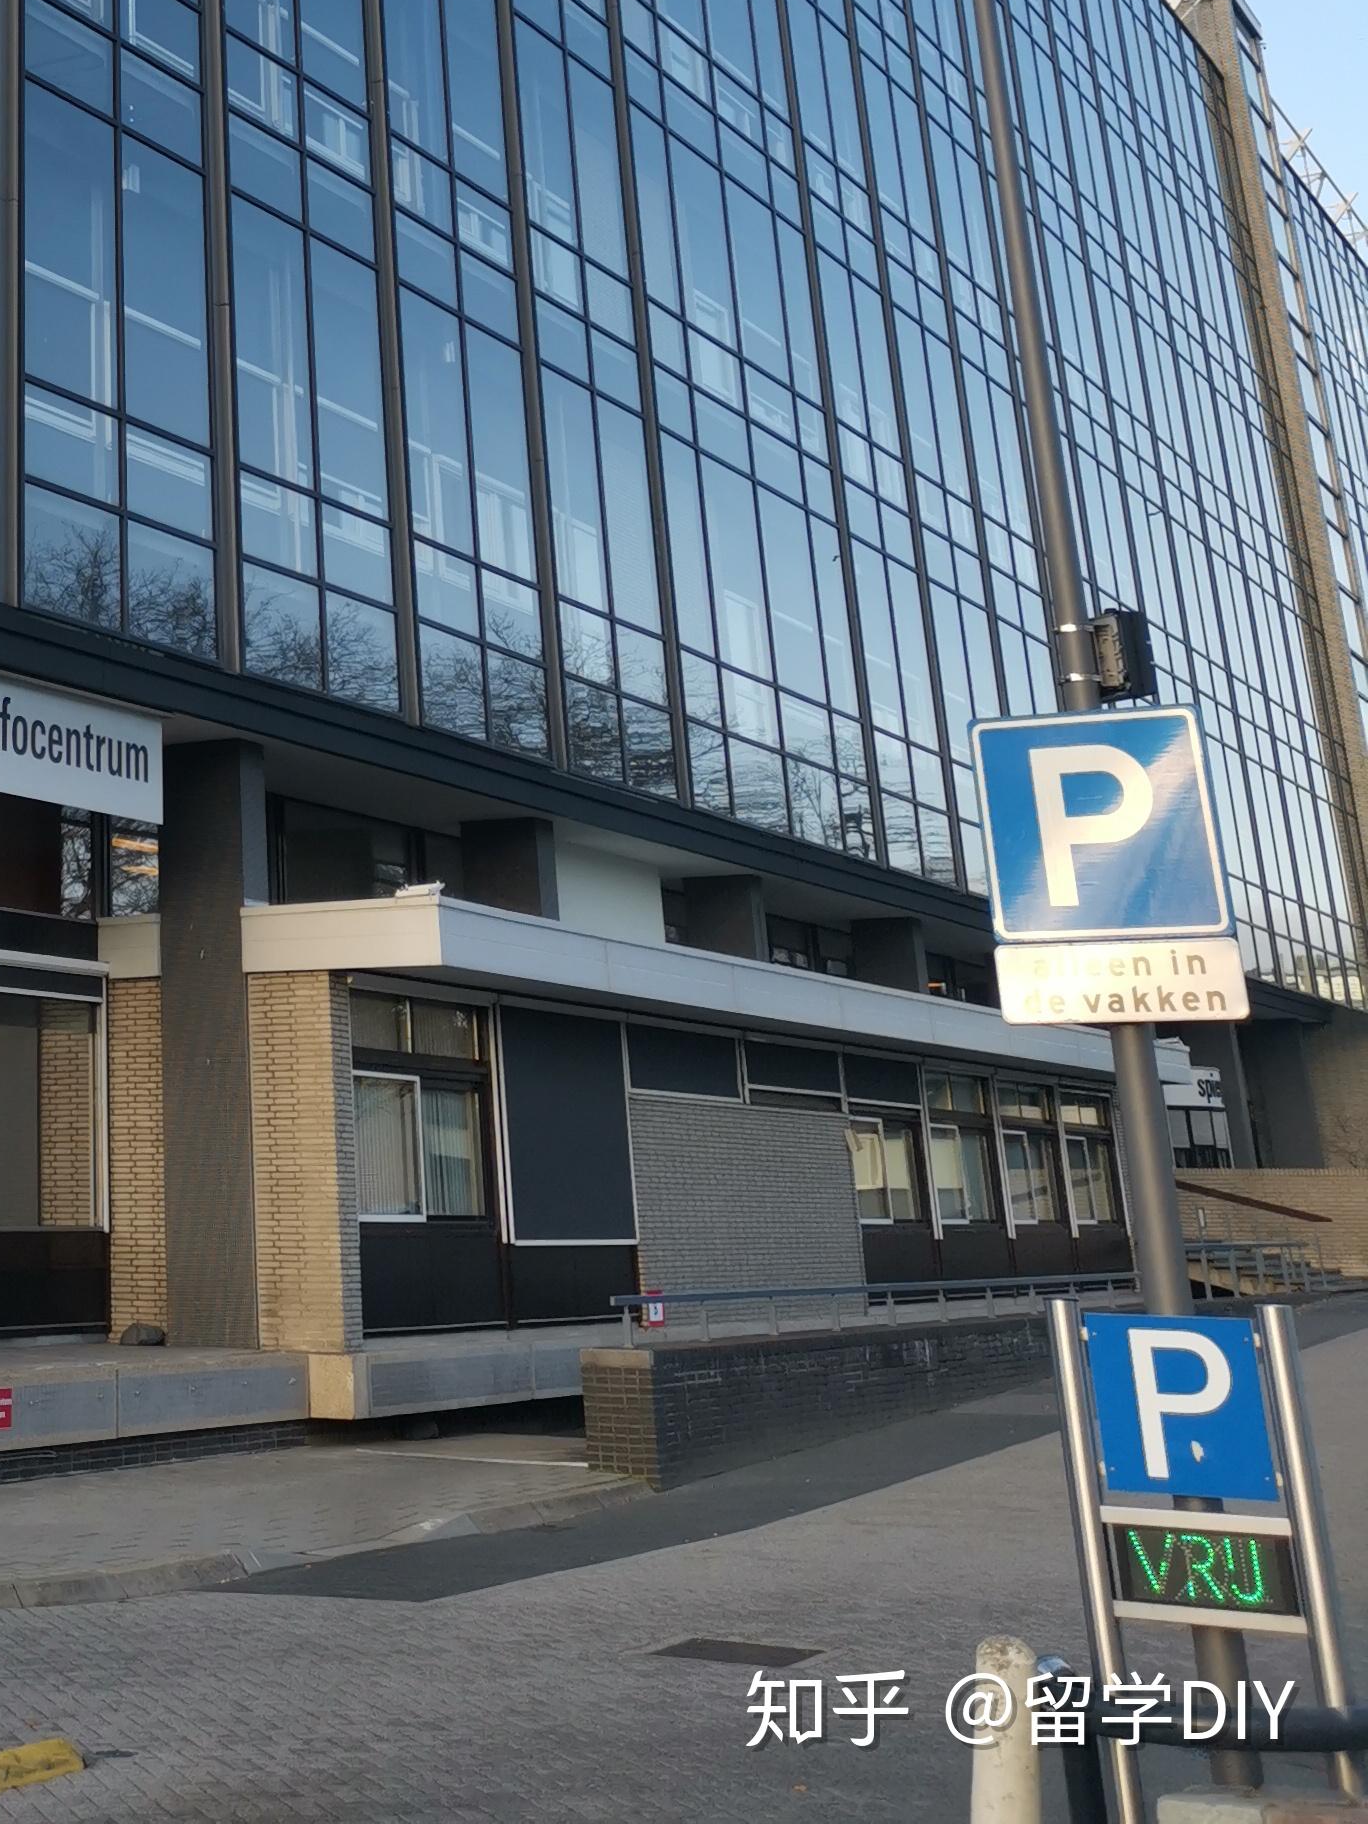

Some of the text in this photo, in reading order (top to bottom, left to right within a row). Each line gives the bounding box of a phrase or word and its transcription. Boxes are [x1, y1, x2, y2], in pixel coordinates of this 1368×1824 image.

[1029, 744, 1153, 907] P
[1082, 986, 1227, 1014] vakken
[1170, 949, 1207, 975] in
[1128, 1329, 1232, 1479] P
